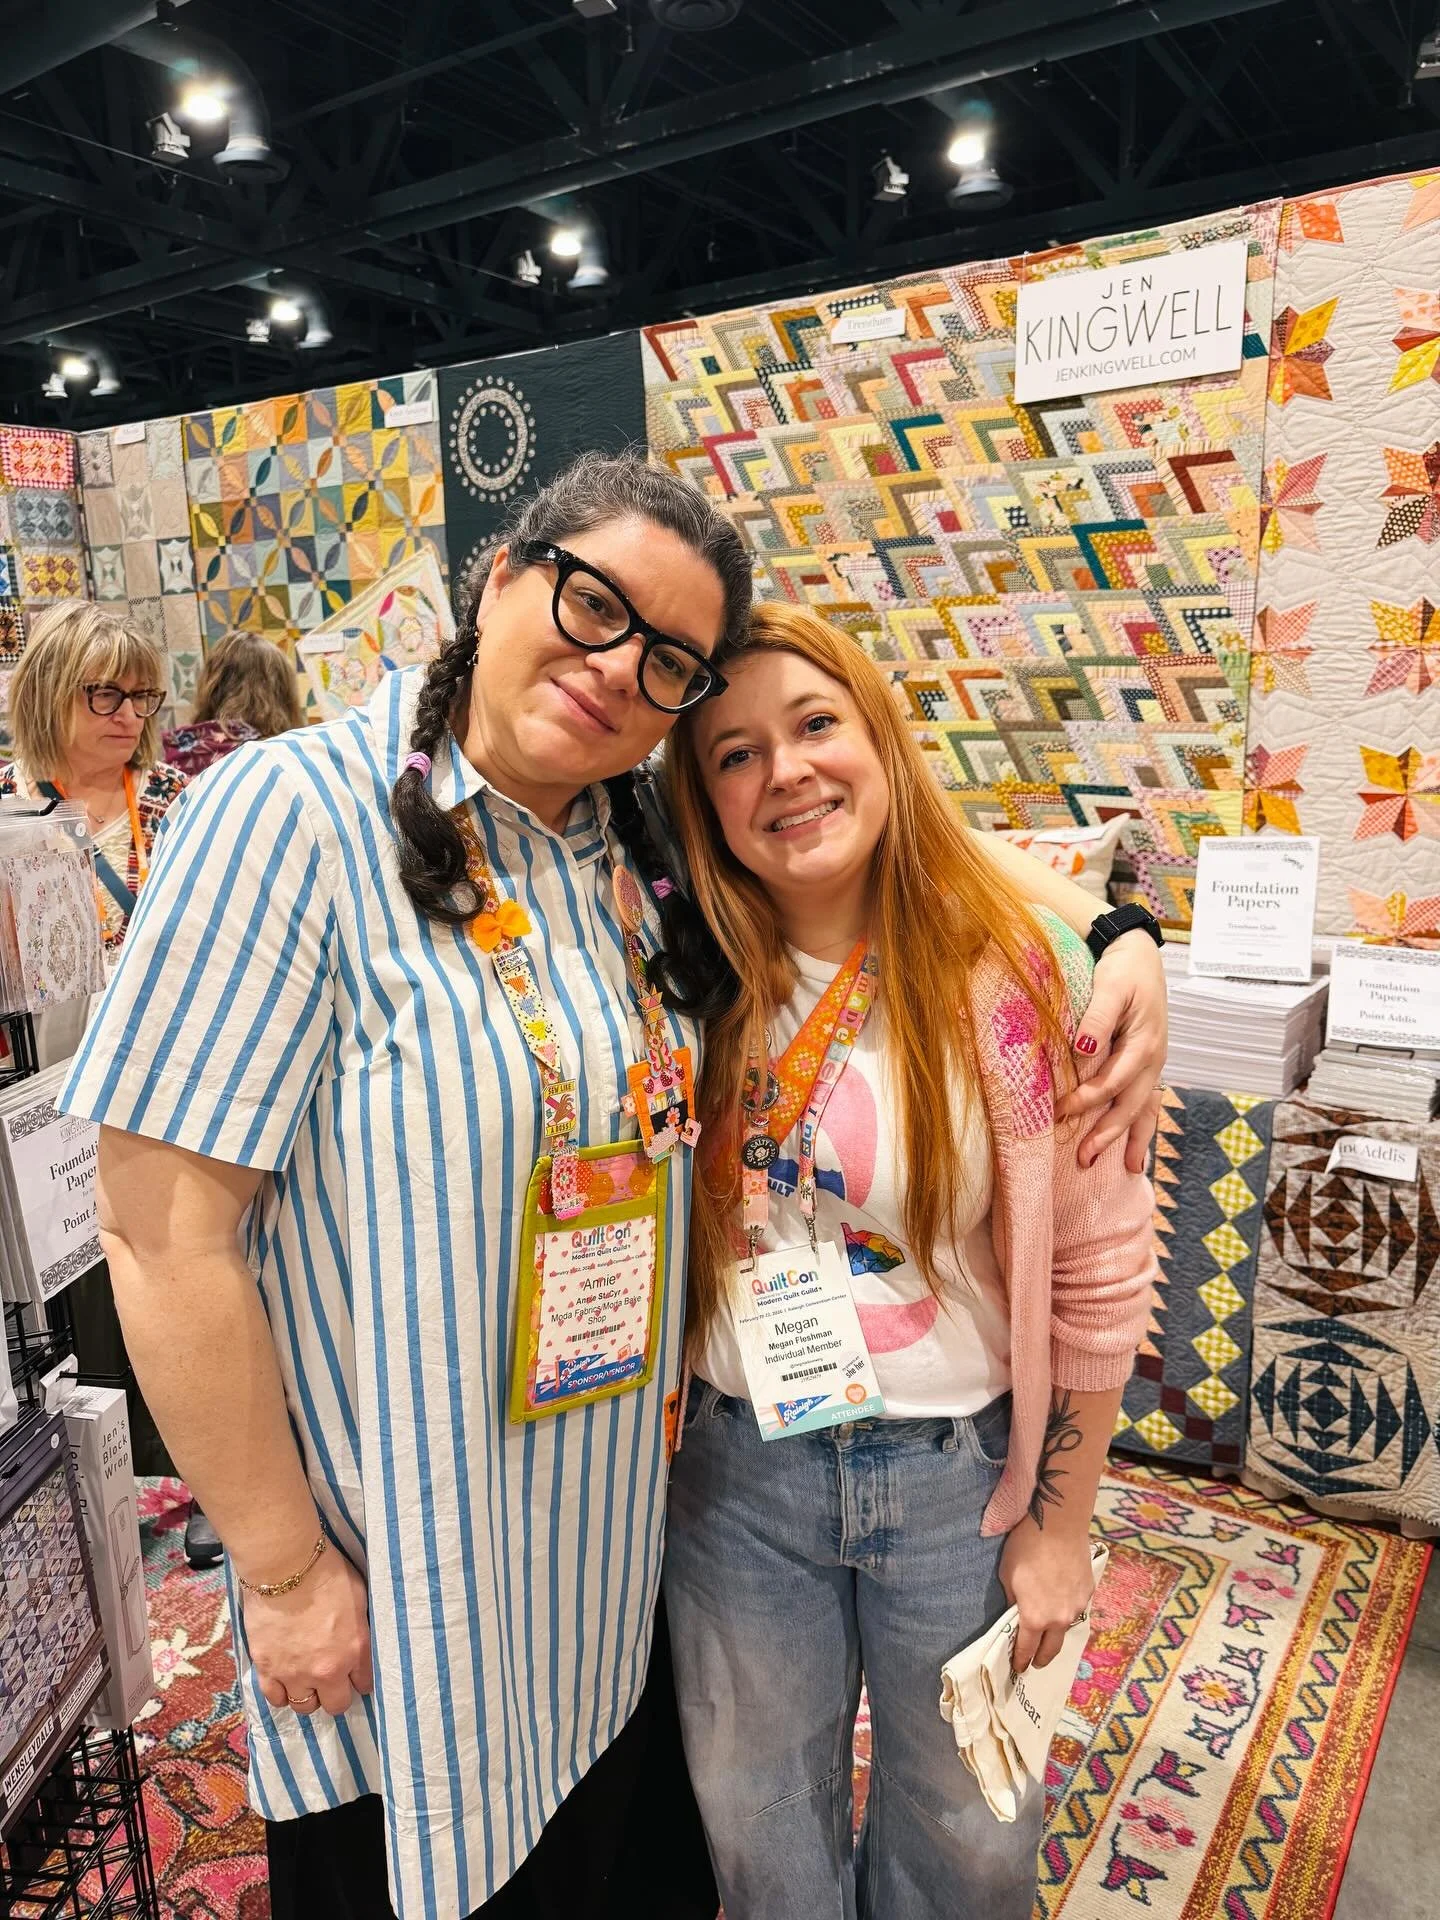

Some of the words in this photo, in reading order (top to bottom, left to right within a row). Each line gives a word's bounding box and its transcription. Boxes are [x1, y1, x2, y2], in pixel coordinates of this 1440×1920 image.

[1102, 275, 1152, 300] JEN
[1025, 284, 1232, 366] KINGWELL
[1055, 347, 1197, 383] JENKINGWELL.COM
[1211, 880, 1300, 896] Foundation
[1227, 895, 1281, 912] Papers
[1359, 979, 1421, 993] Foundation
[1370, 991, 1408, 1003] Papers
[1359, 1010, 1386, 1020] Point
[1388, 1014, 1417, 1024] Addis
[750, 1139, 769, 1150] SALTY
[1361, 1144, 1406, 1163] Addis
[50, 1140, 99, 1181] Foundati
[63, 1208, 90, 1234] Point
[571, 1224, 631, 1249] QuiltCon
[571, 1251, 596, 1261] Modern
[596, 1247, 612, 1257] Quilt
[613, 1244, 628, 1254] Guild
[583, 1273, 616, 1291] Annie
[751, 1269, 819, 1296] QuiltCon
[576, 1294, 597, 1306] Annie
[757, 1297, 783, 1308] Modern
[783, 1291, 800, 1301] Quilt
[800, 1286, 819, 1296] Guild
[551, 1311, 573, 1323] Moda
[624, 1295, 642, 1307] Bake
[587, 1313, 607, 1326] Shop
[774, 1317, 819, 1336] Megan
[768, 1338, 794, 1351] Megan
[795, 1329, 833, 1345] Fleshman
[765, 1347, 806, 1365] Individual
[806, 1339, 843, 1356] Member
[567, 1361, 636, 1390] SPONSOR/VENDOR
[845, 1367, 857, 1379] she
[855, 1359, 866, 1370] her
[783, 1397, 814, 1422] Raleigh
[831, 1403, 876, 1421] ATTENDEE
[102, 1418, 126, 1448] Jen's
[102, 1434, 128, 1465] Block
[104, 1452, 129, 1480] Wrap
[4, 1719, 54, 1794] WENSLEYDALE
